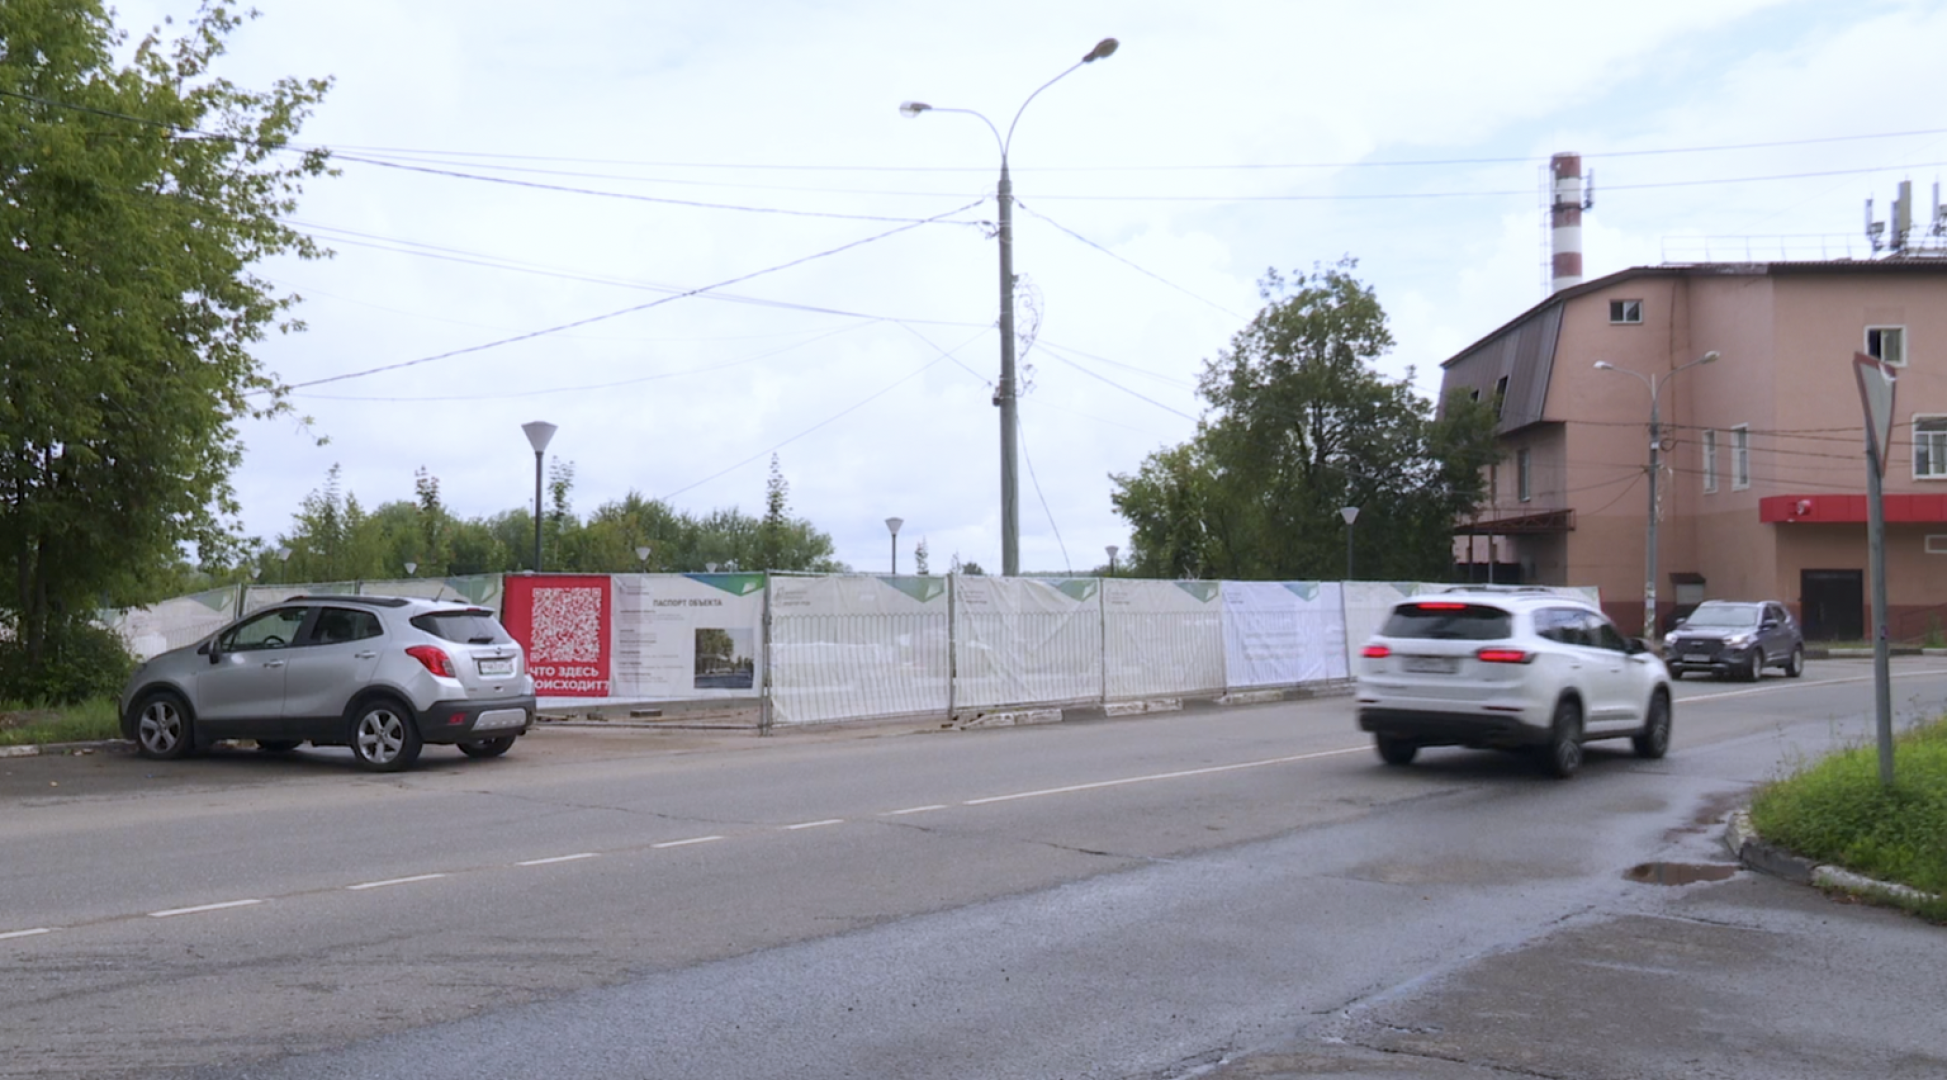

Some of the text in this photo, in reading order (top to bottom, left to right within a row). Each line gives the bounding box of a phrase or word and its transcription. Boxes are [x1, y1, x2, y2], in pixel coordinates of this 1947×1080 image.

[653, 598, 722, 607] ПАСПОРТ ОБЪЕКТА
[530, 666, 599, 678] ЧТО ЗДЕСЬ
[534, 680, 610, 692] ОИСХОДИТ?
